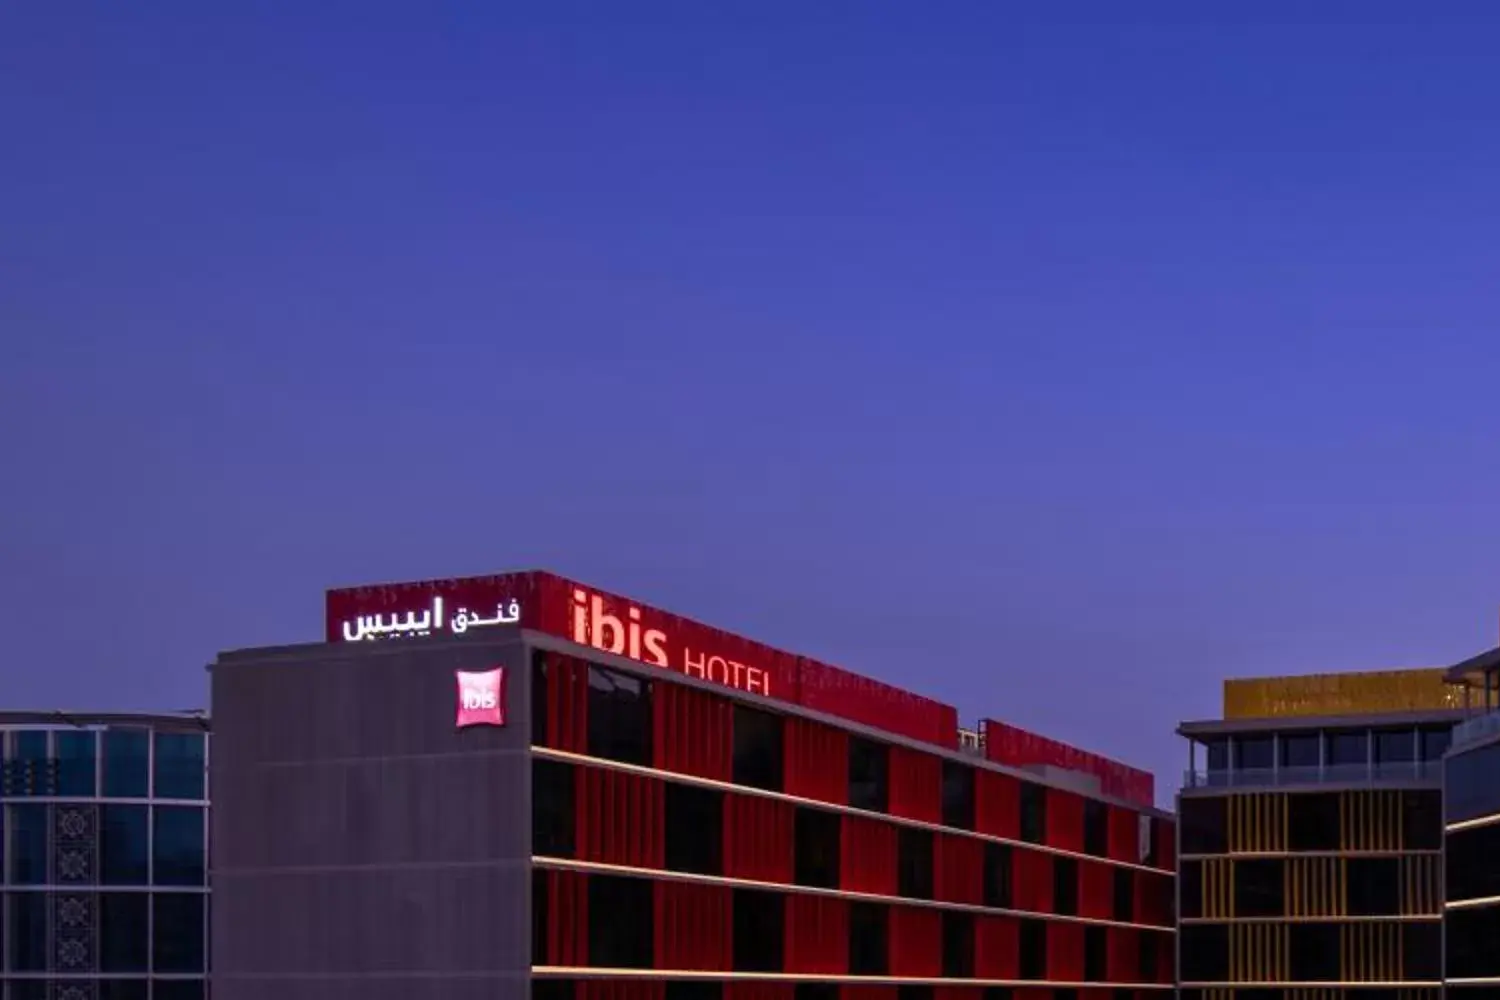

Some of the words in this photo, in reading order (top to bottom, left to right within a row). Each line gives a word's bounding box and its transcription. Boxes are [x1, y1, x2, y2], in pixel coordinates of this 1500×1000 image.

[450, 597, 520, 634] فندق
[572, 587, 669, 669] ibis
[462, 684, 498, 710] ibis
